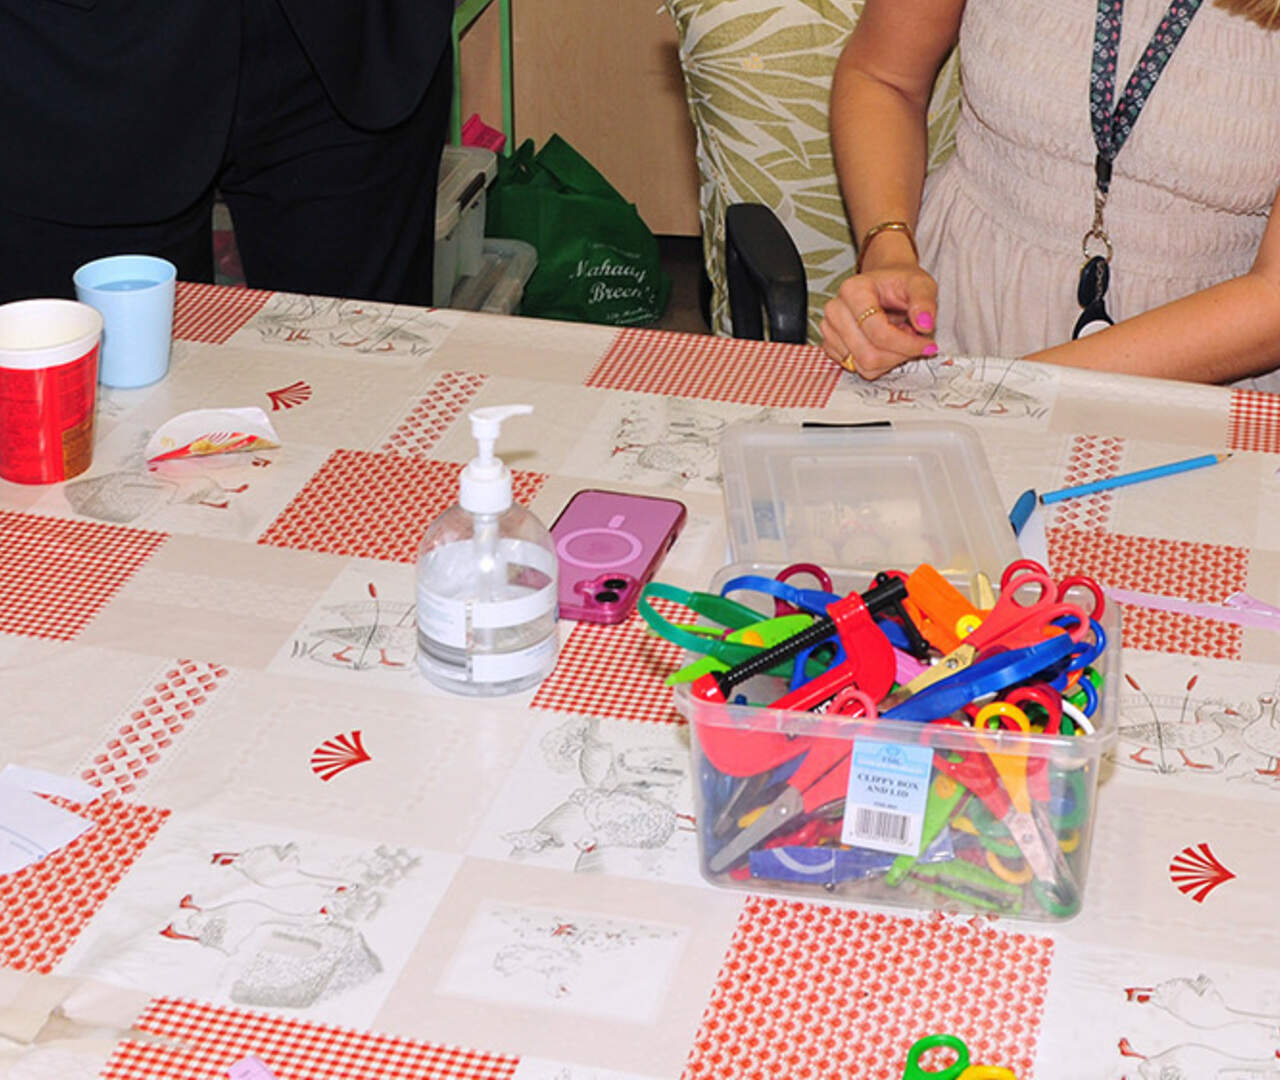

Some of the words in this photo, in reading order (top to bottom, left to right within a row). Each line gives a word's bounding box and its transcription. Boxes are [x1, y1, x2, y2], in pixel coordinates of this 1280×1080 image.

[857, 772, 894, 786] CLIPPY
[896, 779, 919, 791] BOX
[865, 785, 888, 794] AND
